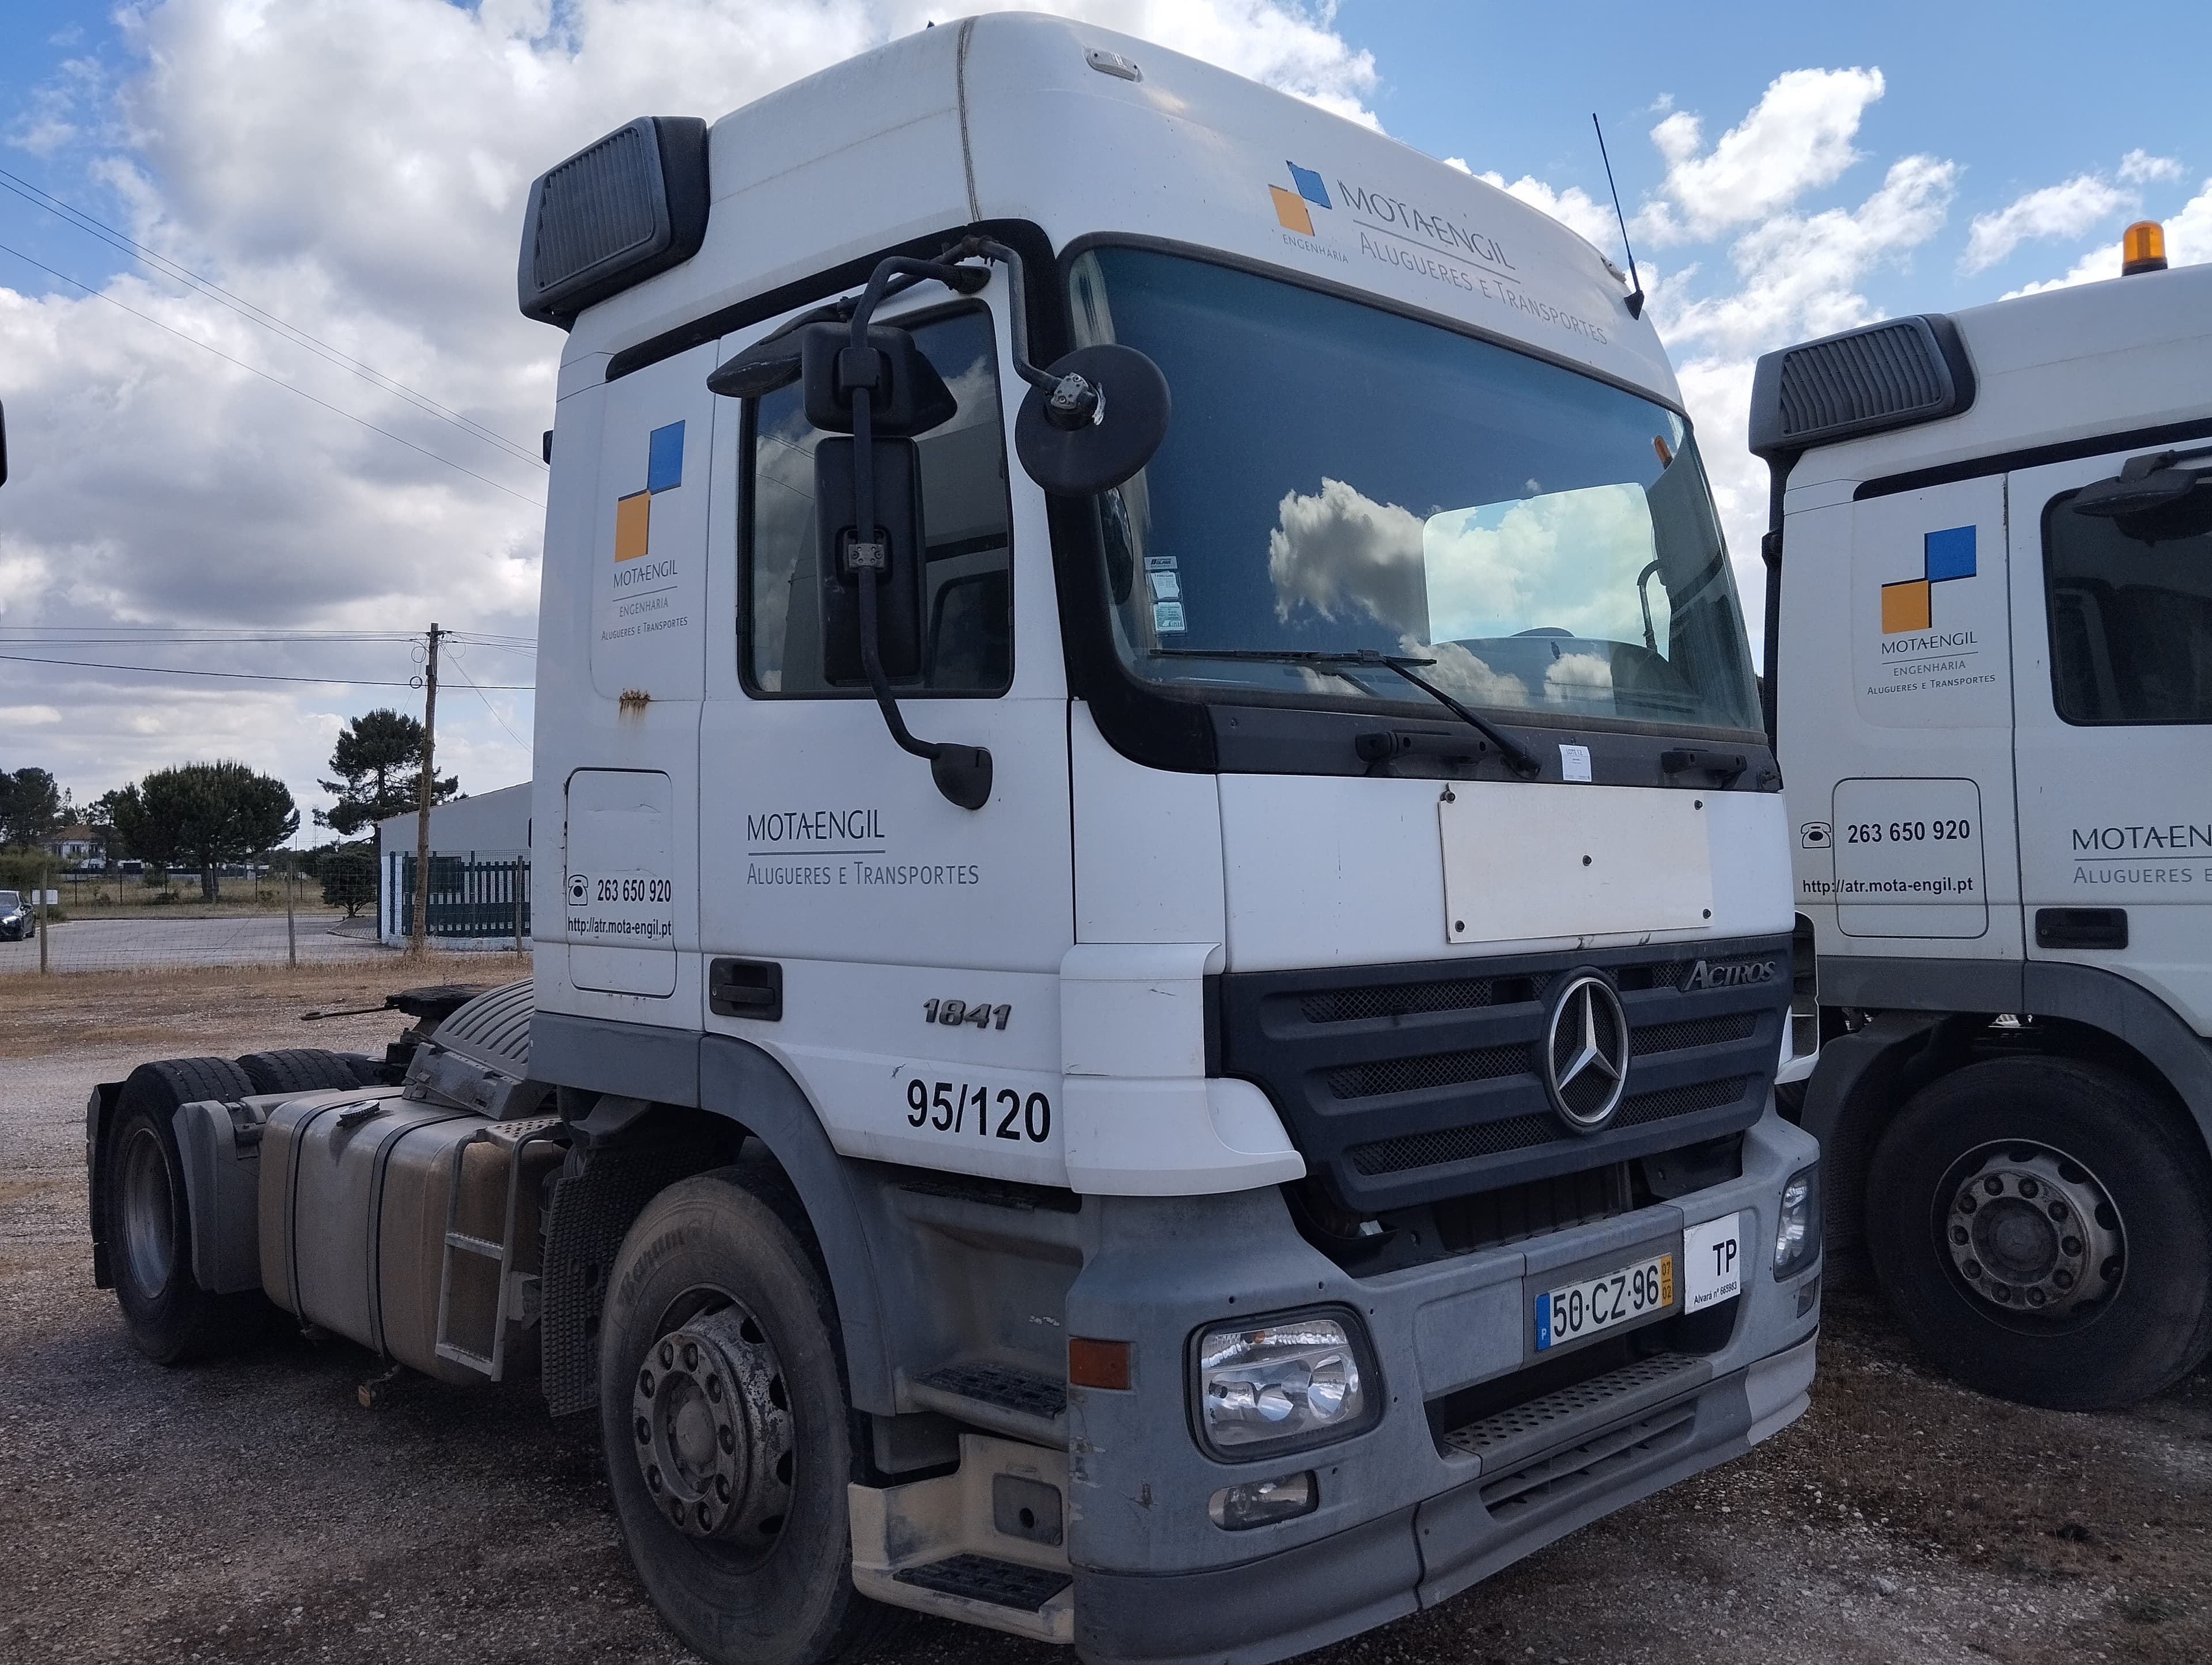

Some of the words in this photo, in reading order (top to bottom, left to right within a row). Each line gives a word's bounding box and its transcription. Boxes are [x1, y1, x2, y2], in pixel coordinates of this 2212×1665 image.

[1282, 234, 1349, 264] ENGENHARIA
[1359, 233, 1473, 291] ALUGUERES
[1483, 279, 1493, 299] E
[1493, 280, 1608, 345] TRANSPORTES
[619, 597, 669, 617] ENGENHARIA
[601, 627, 635, 641] ALUGUERES
[637, 625, 641, 634] E
[643, 616, 688, 634] TRANSPORTES
[1893, 660, 1966, 677] ENGENHARIA
[1867, 682, 1918, 695] ALUGUERES
[1930, 674, 1996, 689] TRANSPORTES
[1847, 823, 1883, 843] 263
[1889, 821, 1925, 841] 650
[1933, 820, 1970, 840] 920
[747, 863, 831, 885] ALUGUERES
[839, 867, 847, 885] E
[854, 861, 979, 885] TRANSPORTES
[2073, 866, 2192, 883] ALUGUERES
[597, 879, 619, 902] 263
[623, 879, 645, 902] 650
[649, 879, 671, 902] 920
[1802, 877, 1973, 896] http://atr.mota-engil.pt
[568, 916, 672, 939] http://atr.mota-engil.pt
[923, 998, 1012, 1030] 1841
[907, 1079, 1051, 1143] 95/120
[1661, 1261, 1671, 1276] 07
[1713, 1238, 1737, 1277] TP
[1662, 1285, 1672, 1300] 02
[1694, 1291, 1712, 1304] Alvará
[1541, 1328, 1547, 1340] P
